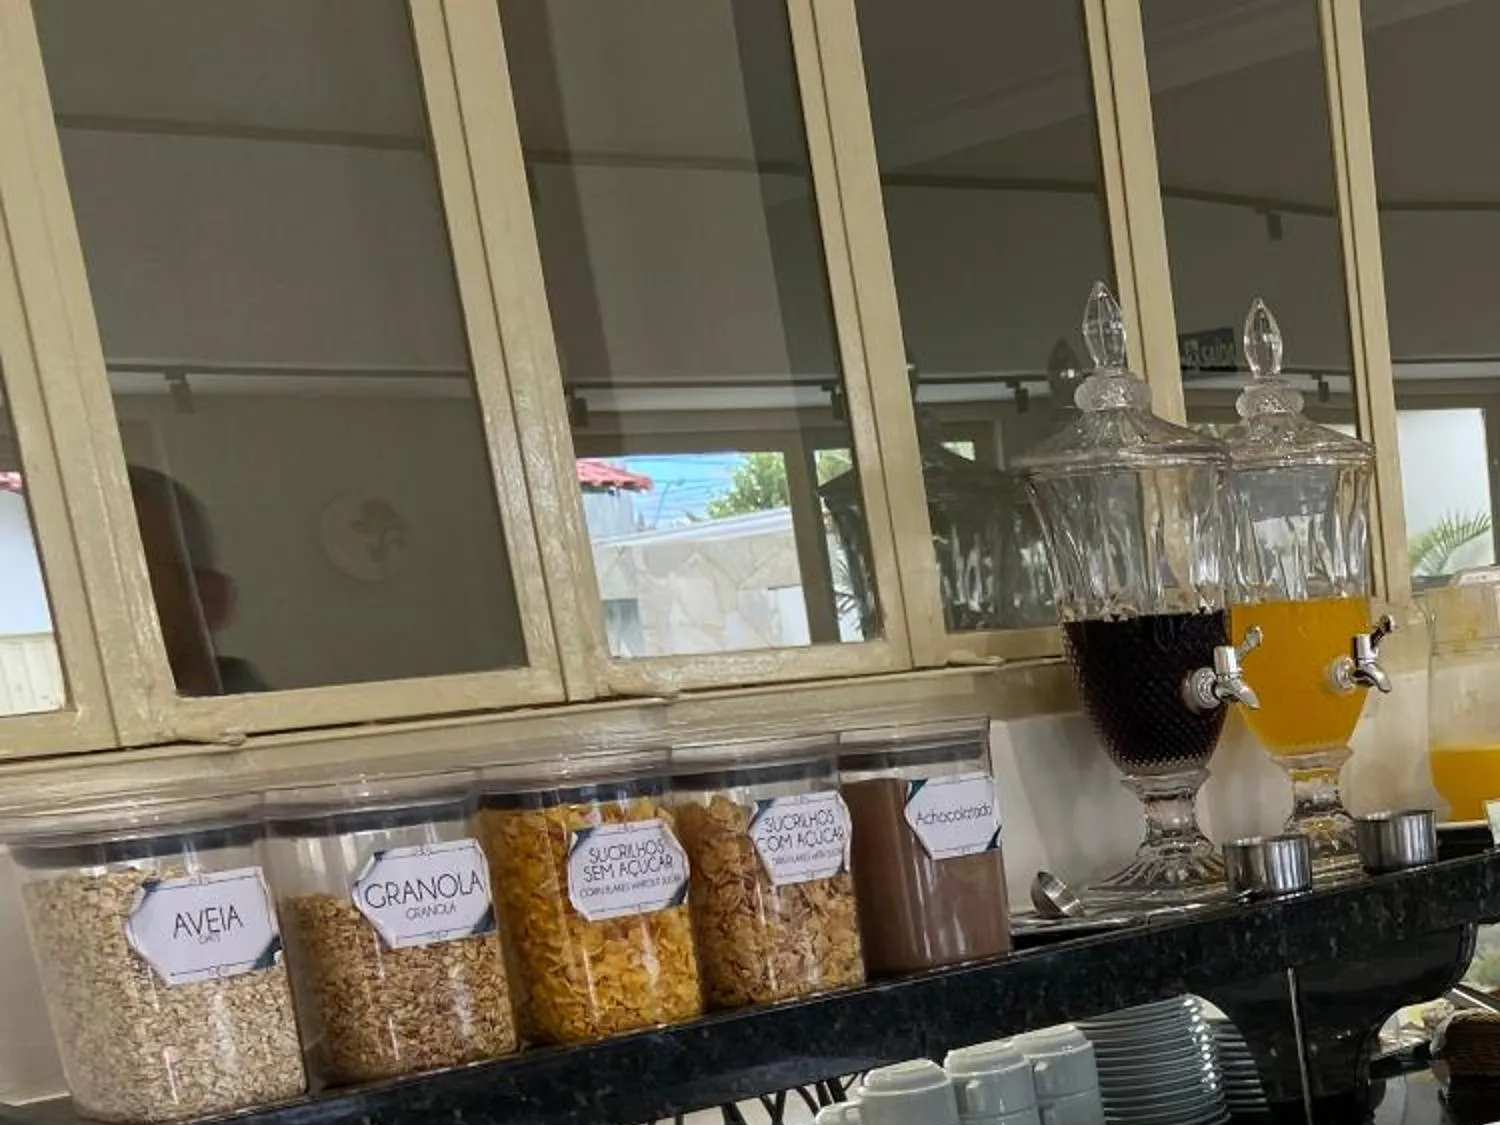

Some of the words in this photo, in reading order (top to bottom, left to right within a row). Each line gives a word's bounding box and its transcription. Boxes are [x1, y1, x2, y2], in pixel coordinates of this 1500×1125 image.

[764, 809, 834, 834] SUCRILHOS
[588, 837, 665, 865] SUCRILHOS
[583, 863, 615, 883] SEM
[364, 869, 485, 909] GRANOLA
[172, 903, 244, 940] AVEIA
[405, 901, 458, 921] GRANOLA
